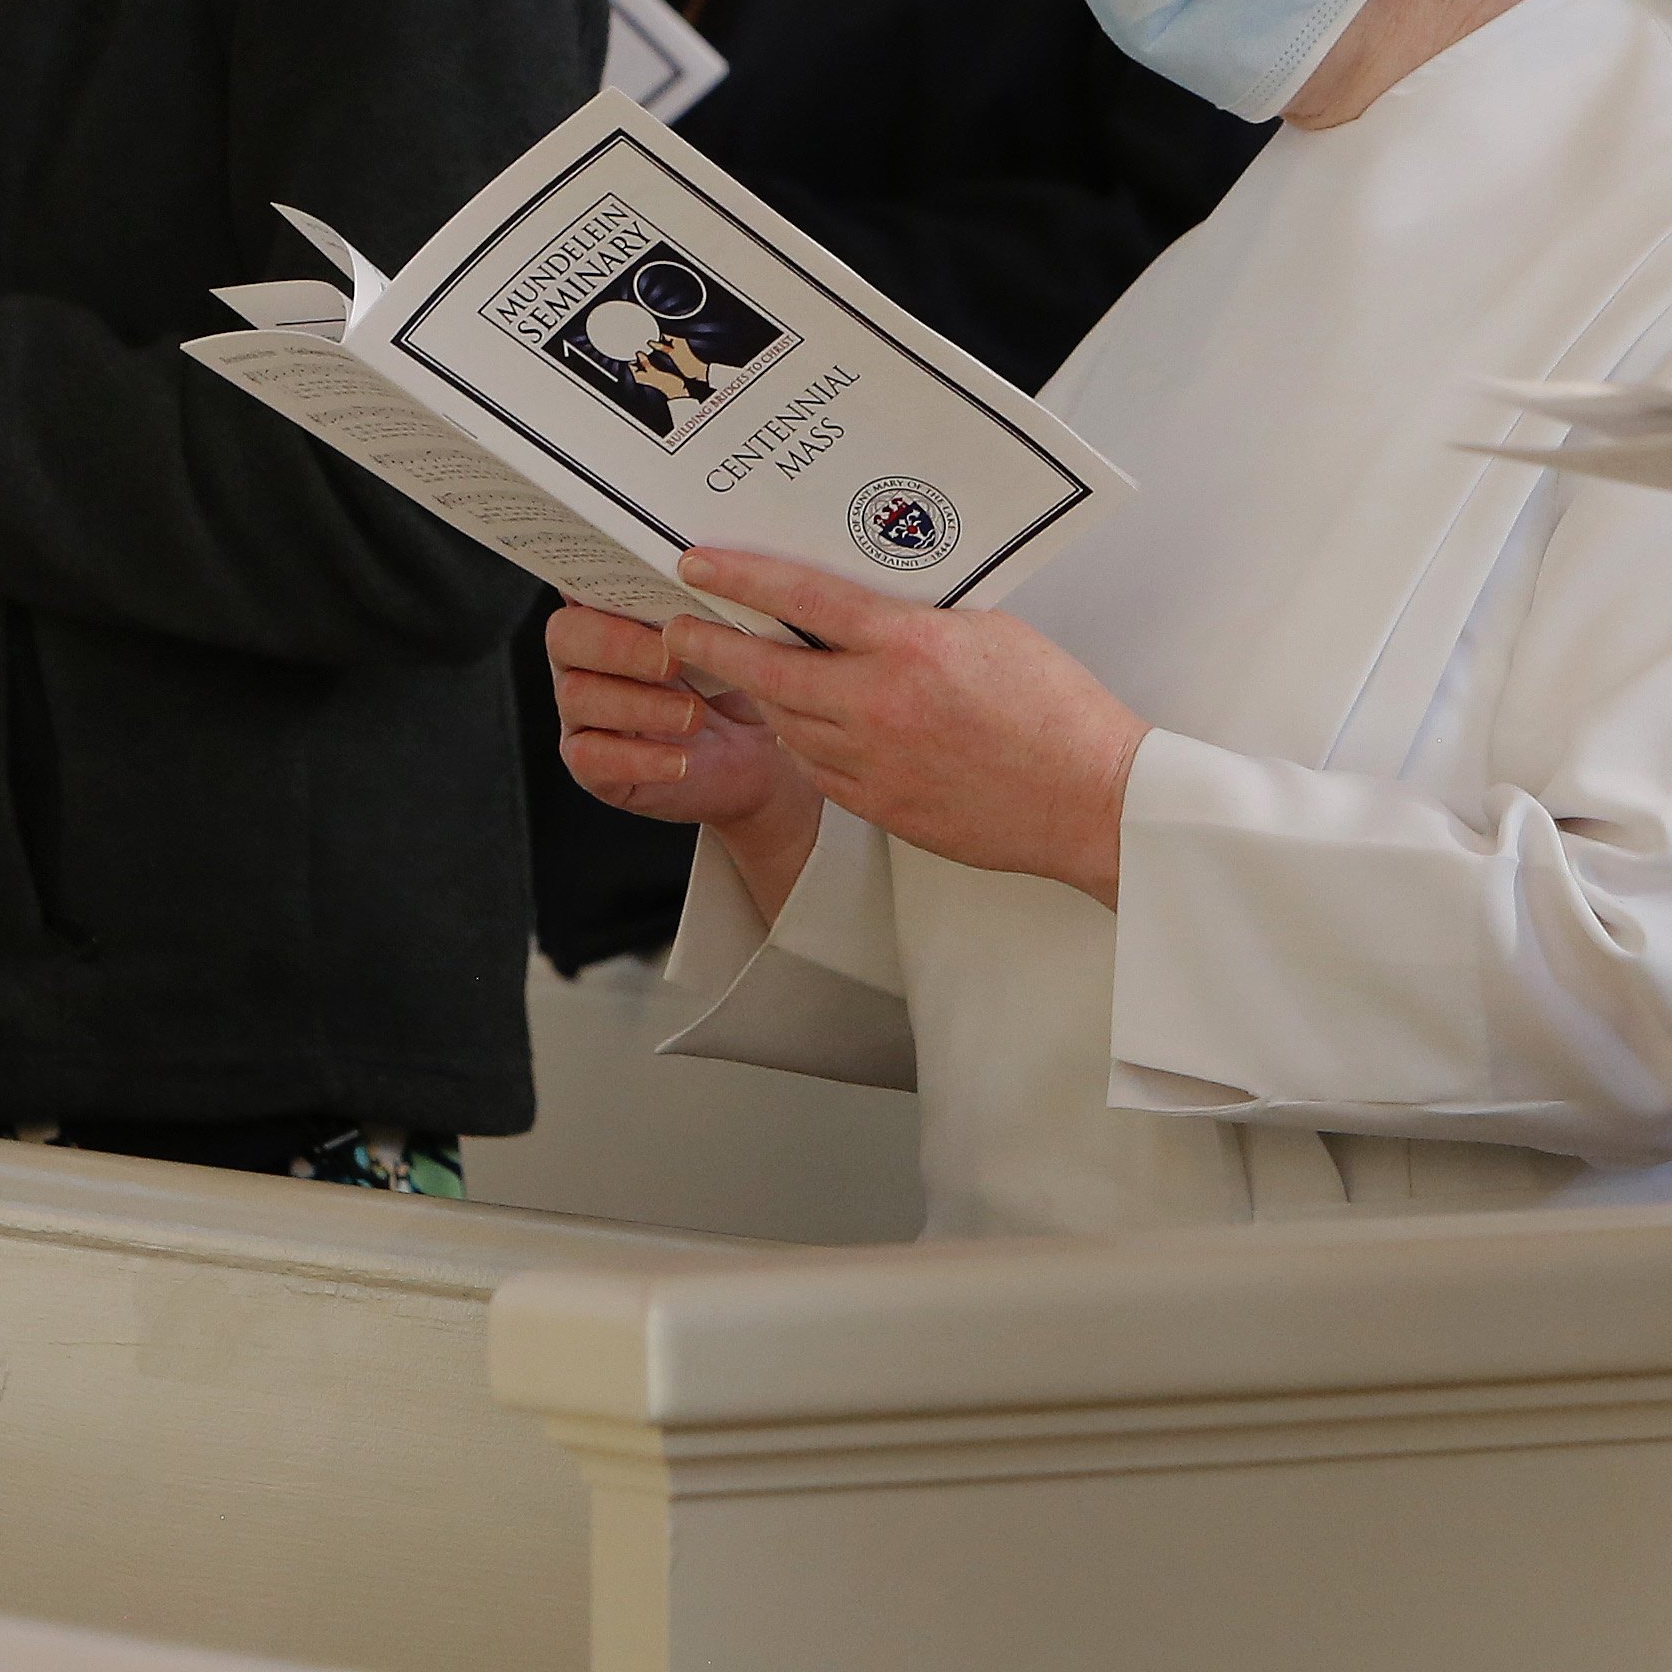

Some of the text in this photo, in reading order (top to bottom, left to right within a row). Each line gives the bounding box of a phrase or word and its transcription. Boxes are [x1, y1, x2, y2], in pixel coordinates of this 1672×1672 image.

[495, 203, 629, 325] MUNDELEIN
[517, 221, 651, 344] SEMINARY
[666, 334, 795, 448] BUILDING BRIDGES TO CHRIST
[706, 365, 861, 493] CENTENNIAL
[775, 417, 845, 481] MASS
[872, 479, 904, 491] MARY
[907, 480, 922, 490] OF
[925, 488, 944, 504] THE
[852, 490, 872, 516] SAINT
[942, 505, 957, 530] LAKE
[857, 535, 919, 567] UNIVERSITY
[931, 541, 952, 562] 1844
